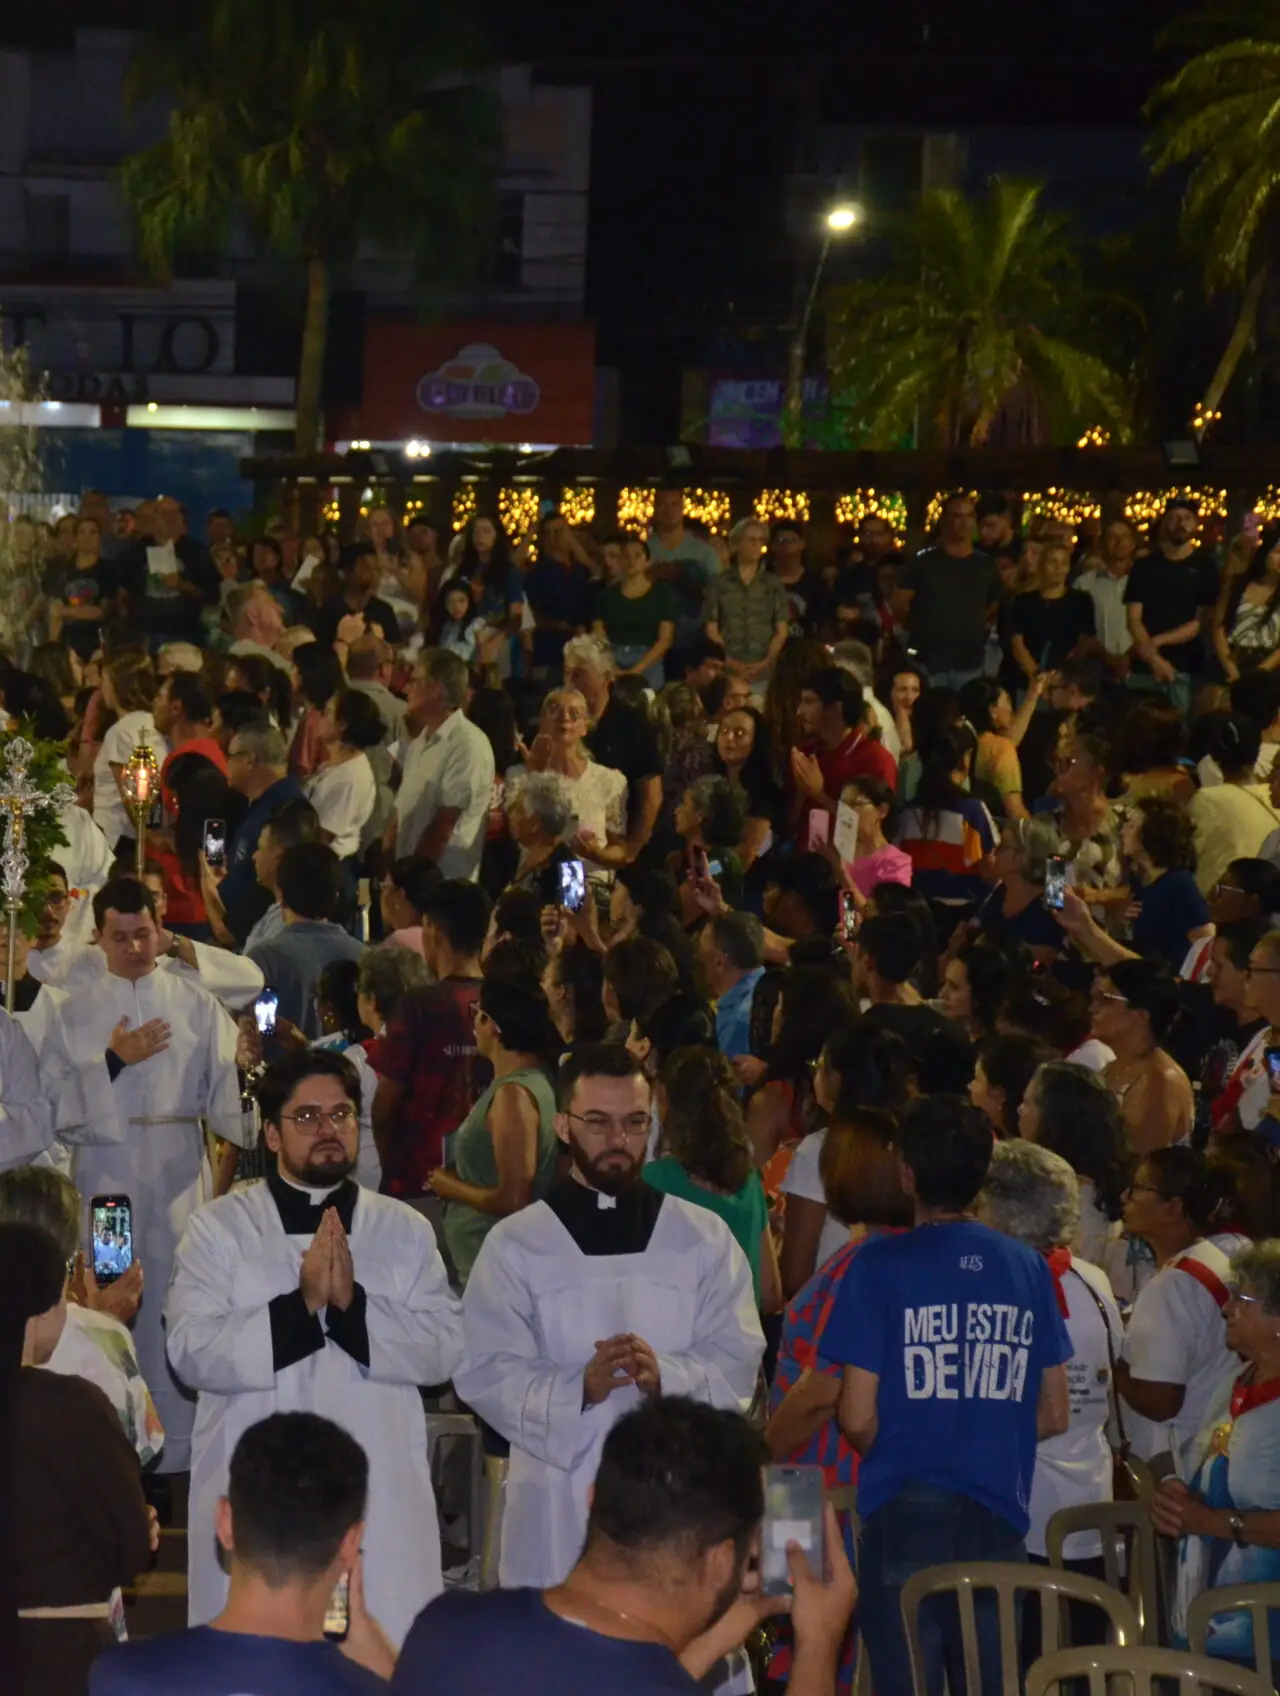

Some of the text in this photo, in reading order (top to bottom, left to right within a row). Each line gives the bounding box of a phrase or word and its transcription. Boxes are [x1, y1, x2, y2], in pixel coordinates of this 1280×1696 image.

[904, 1302, 1034, 1346] MEU ESTILO
[904, 1342, 1028, 1403] DE VIDA
